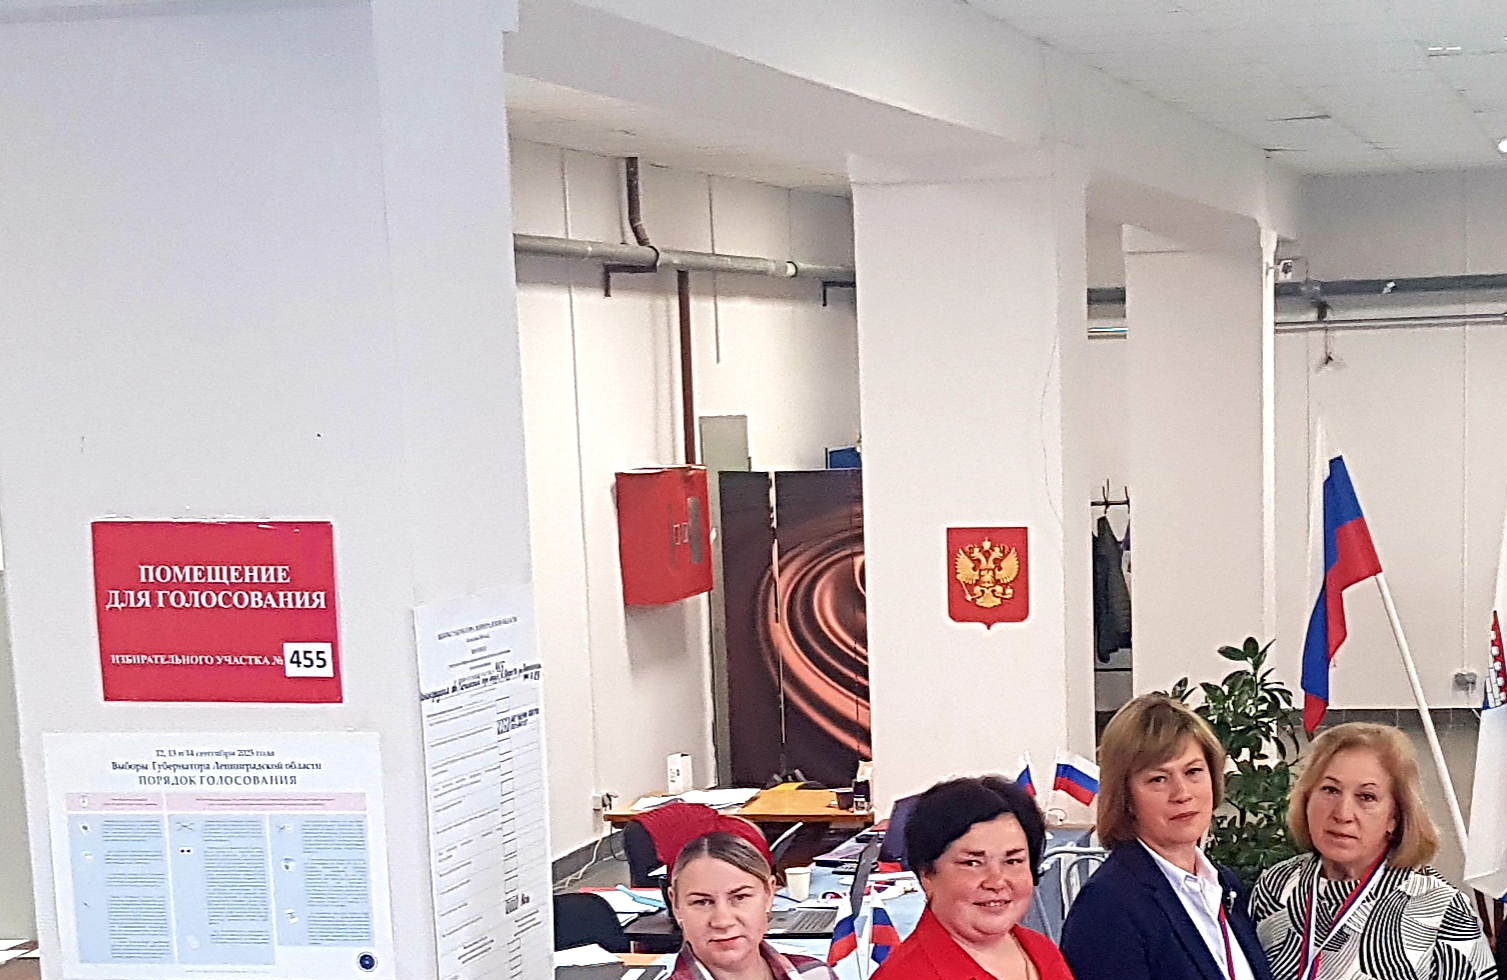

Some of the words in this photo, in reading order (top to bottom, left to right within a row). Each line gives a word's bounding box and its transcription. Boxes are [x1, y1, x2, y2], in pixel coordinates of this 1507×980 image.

[138, 564, 291, 585] ПОМЕЩЕНИЕ
[105, 590, 151, 610] ДЛЯ
[156, 591, 327, 609] ГОЛОСОВАНИЯ
[111, 654, 214, 666] ИЗБИРАТЕЛЬНОГО
[215, 655, 270, 666] УЧАСТКА
[289, 650, 327, 669] 455
[111, 761, 149, 772] Выборы
[152, 761, 210, 773] Губернатора
[212, 762, 283, 773] Ленинградской
[285, 762, 321, 770] области
[139, 775, 197, 786] ПОРЯДОК
[200, 775, 297, 785] ГОЛОСОВАНИЯ
